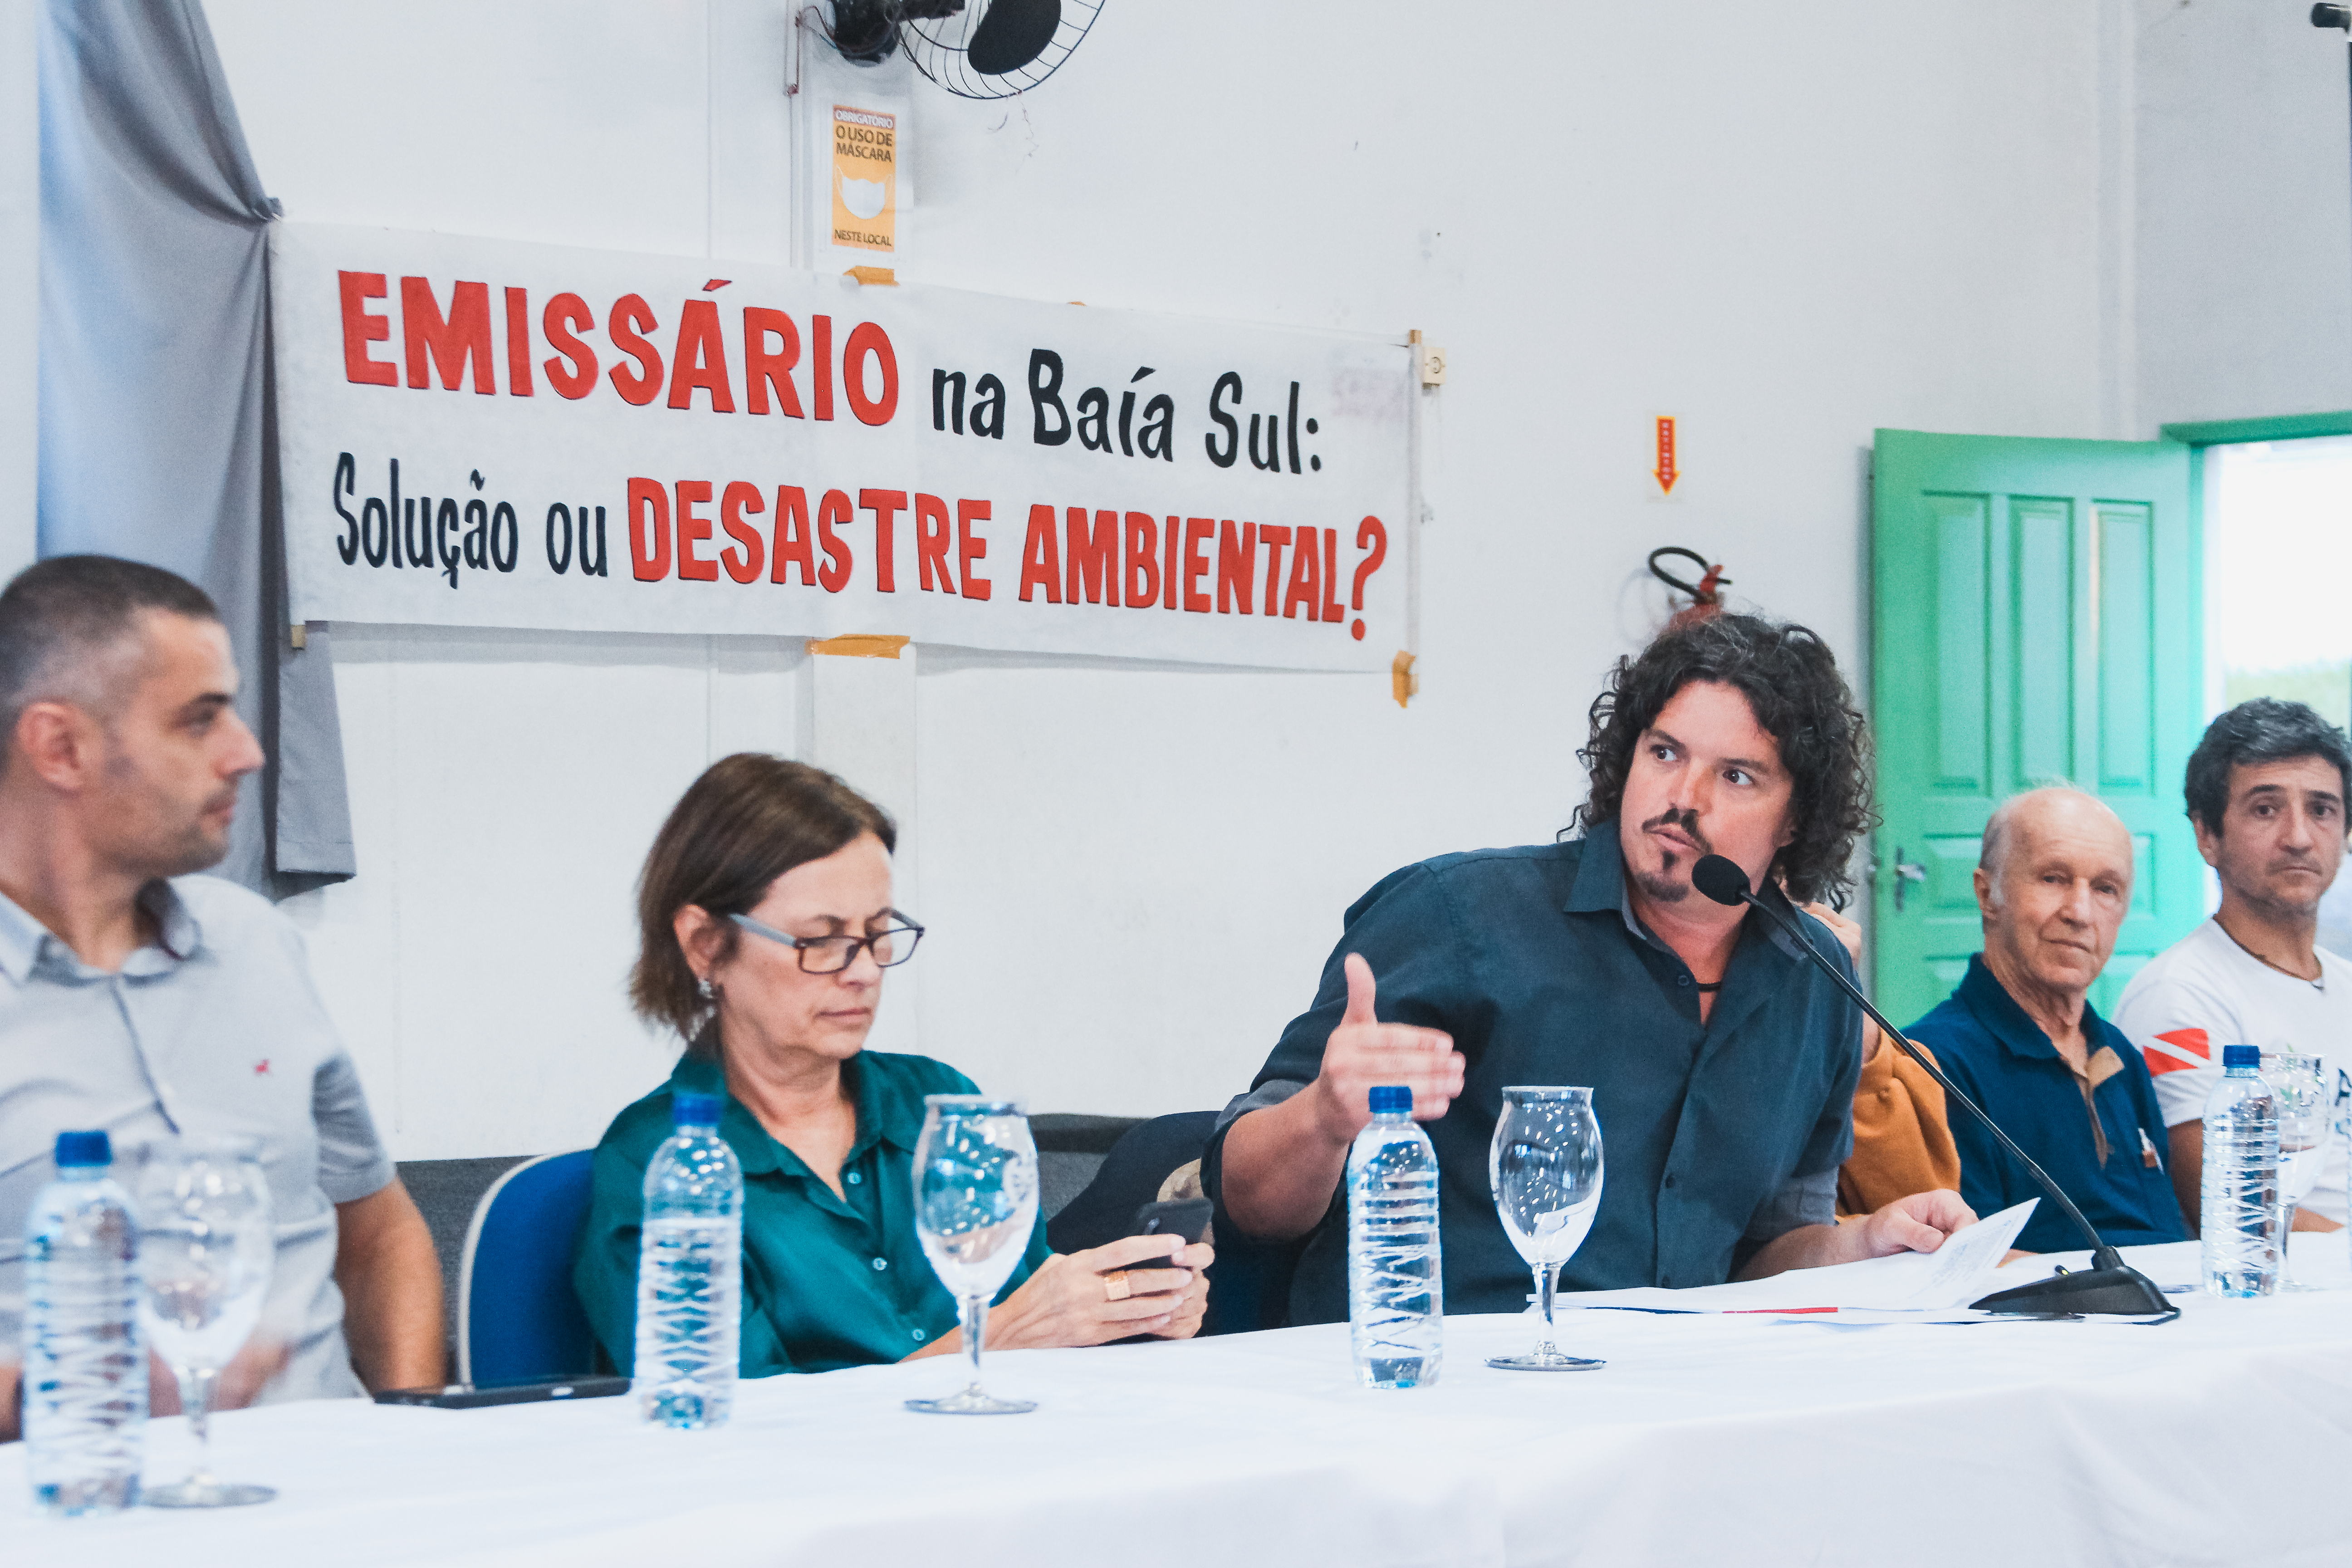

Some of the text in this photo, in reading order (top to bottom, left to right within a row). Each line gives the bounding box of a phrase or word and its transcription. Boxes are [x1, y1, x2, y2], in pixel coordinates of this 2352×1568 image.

[836, 125, 892, 147] O USO DE
[836, 141, 892, 162] MÁSCARA
[834, 229, 892, 246] NESTE LOCAL
[338, 271, 1321, 475] EMISSÁRIO na Baía Sul:
[333, 452, 1387, 640] Solução ou DESASTRE AMBIENTAL?
